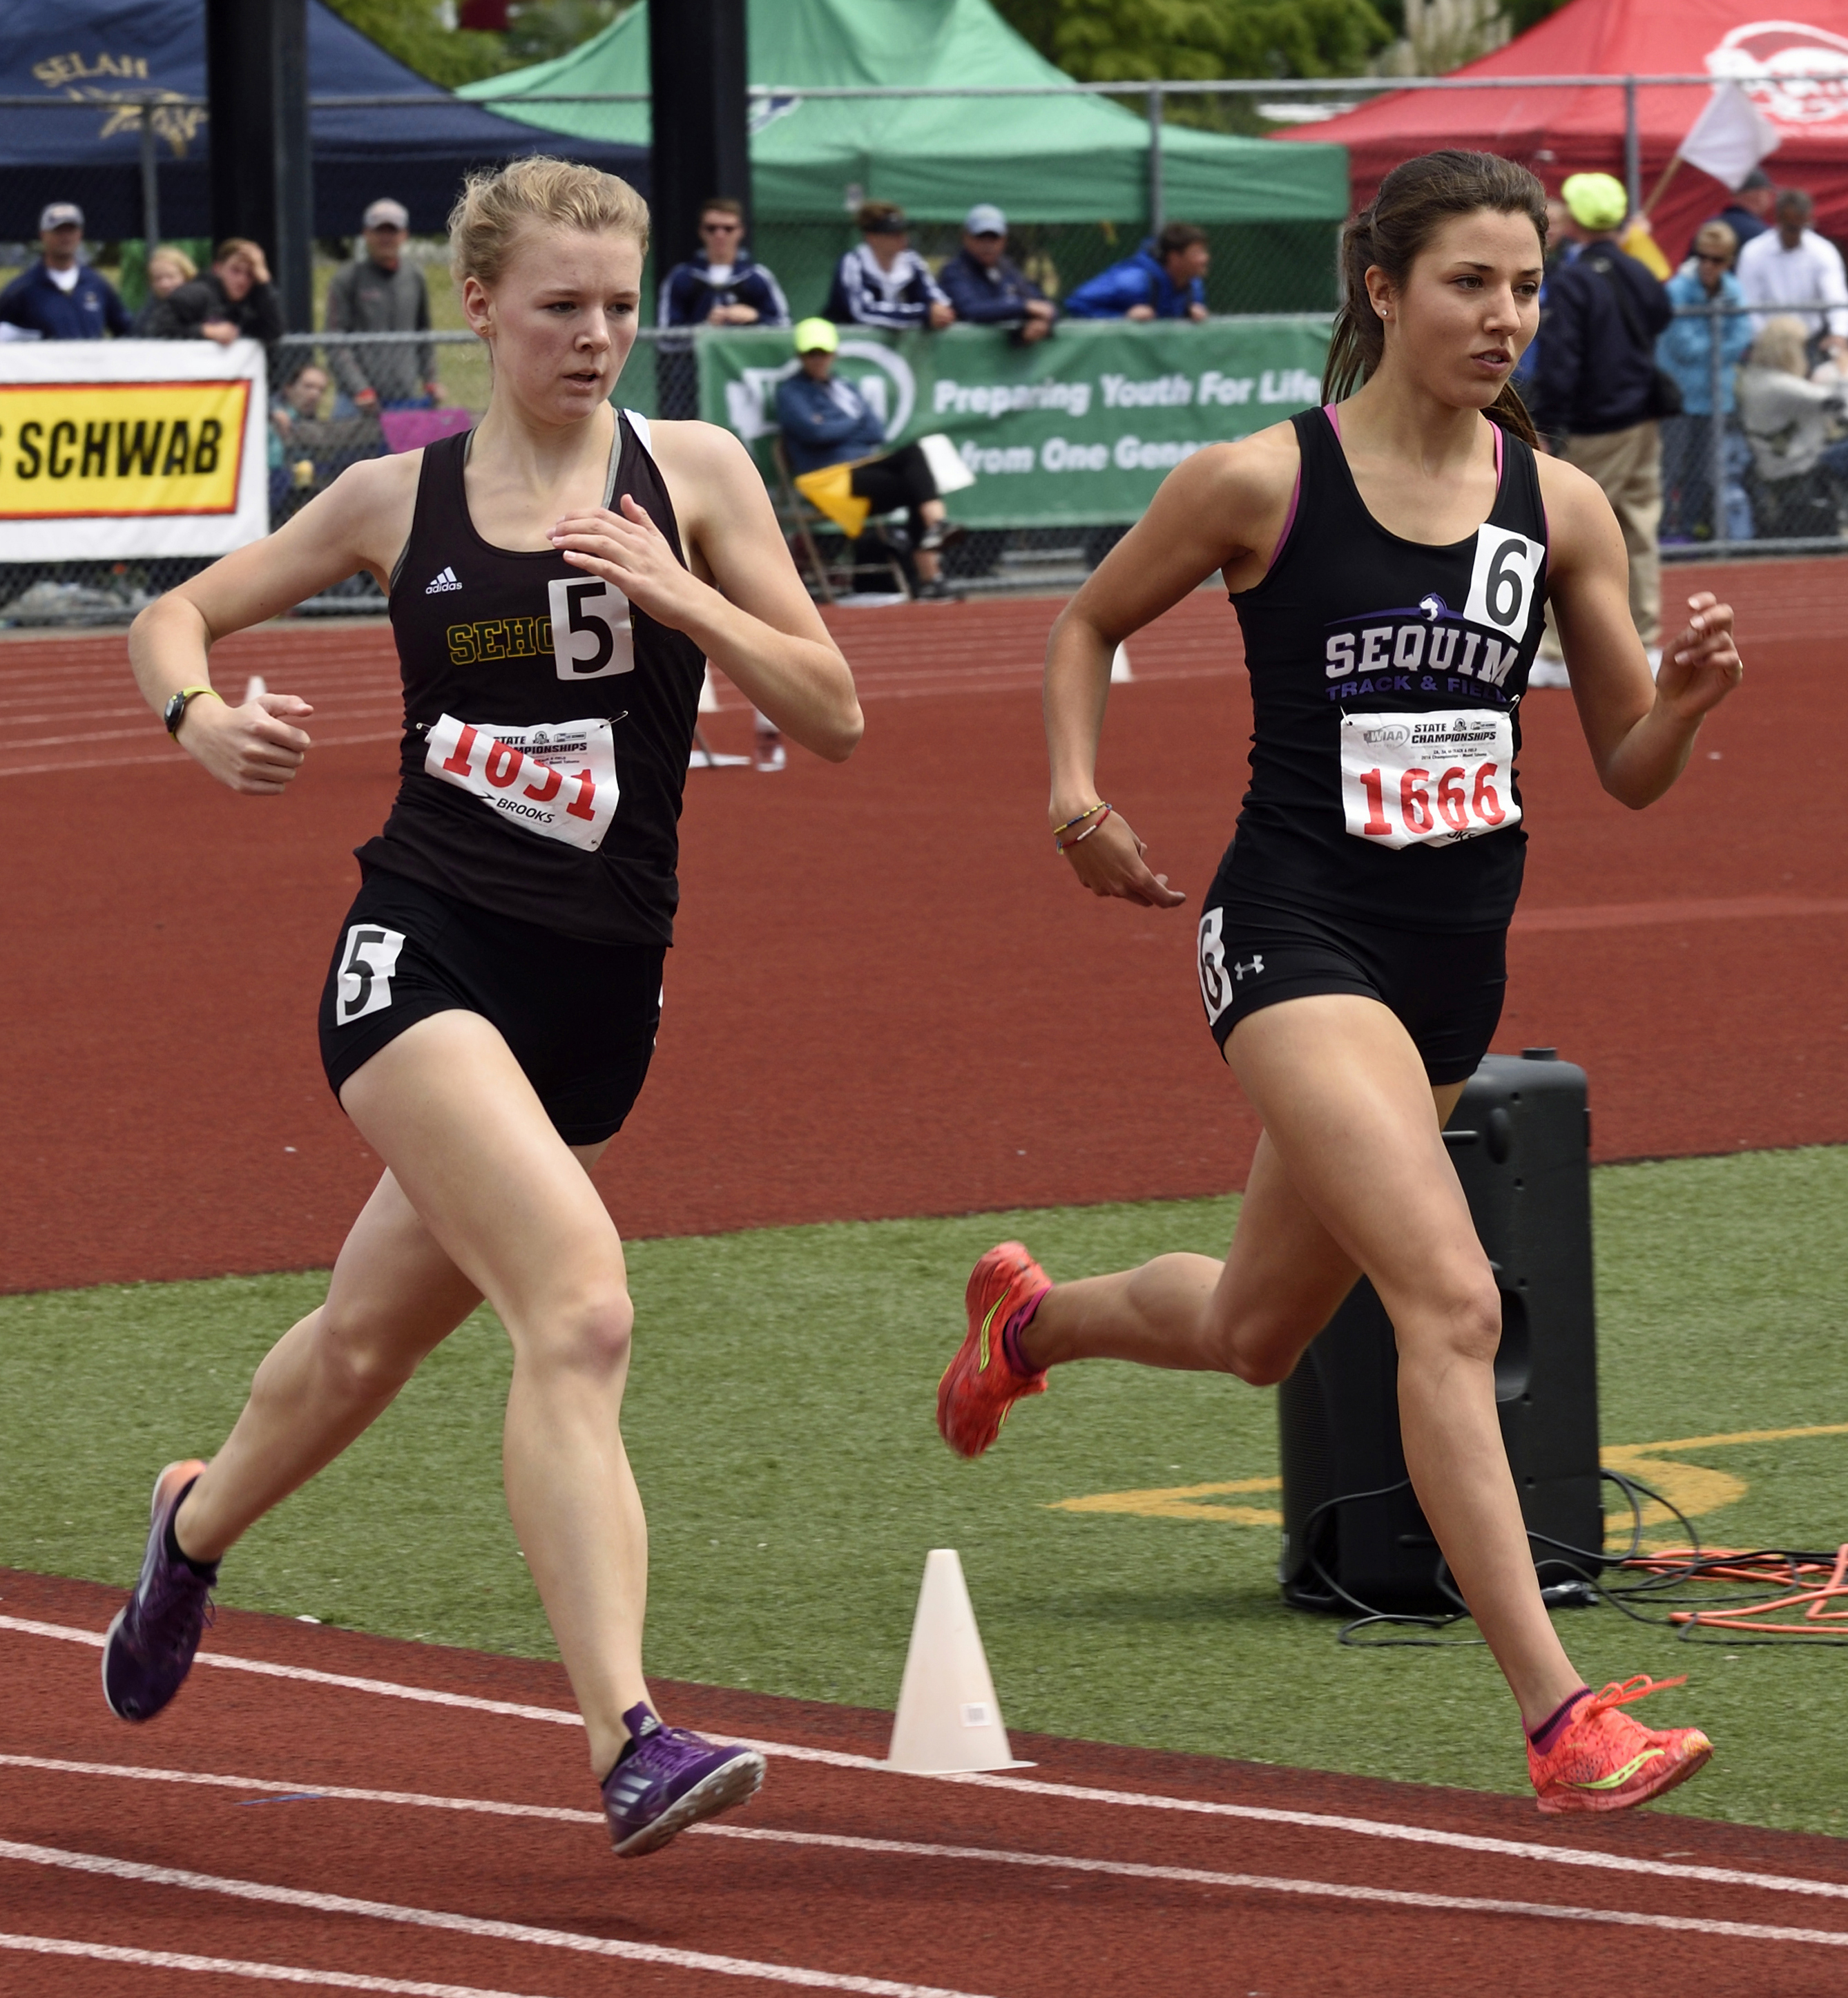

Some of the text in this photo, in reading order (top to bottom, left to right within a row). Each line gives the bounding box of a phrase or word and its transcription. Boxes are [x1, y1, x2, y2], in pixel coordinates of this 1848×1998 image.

[934, 369, 1321, 418] Preparing Youth For Life
[16, 419, 222, 479] SCHWAB
[961, 440, 1034, 474] from
[1041, 436, 1108, 472] One
[425, 580, 463, 595] adidas
[1485, 539, 1527, 626] 6
[566, 582, 614, 673] 5
[1325, 625, 1519, 686] SEQUIM
[1326, 676, 1507, 702] TRACK & FIELD
[1412, 731, 1496, 744] CHAMPIONSHIPS
[1414, 723, 1447, 733] STATE
[497, 798, 555, 824] BROOKS
[1360, 762, 1506, 835] 1666
[343, 930, 376, 1016] 5
[1200, 919, 1223, 1010] 6
